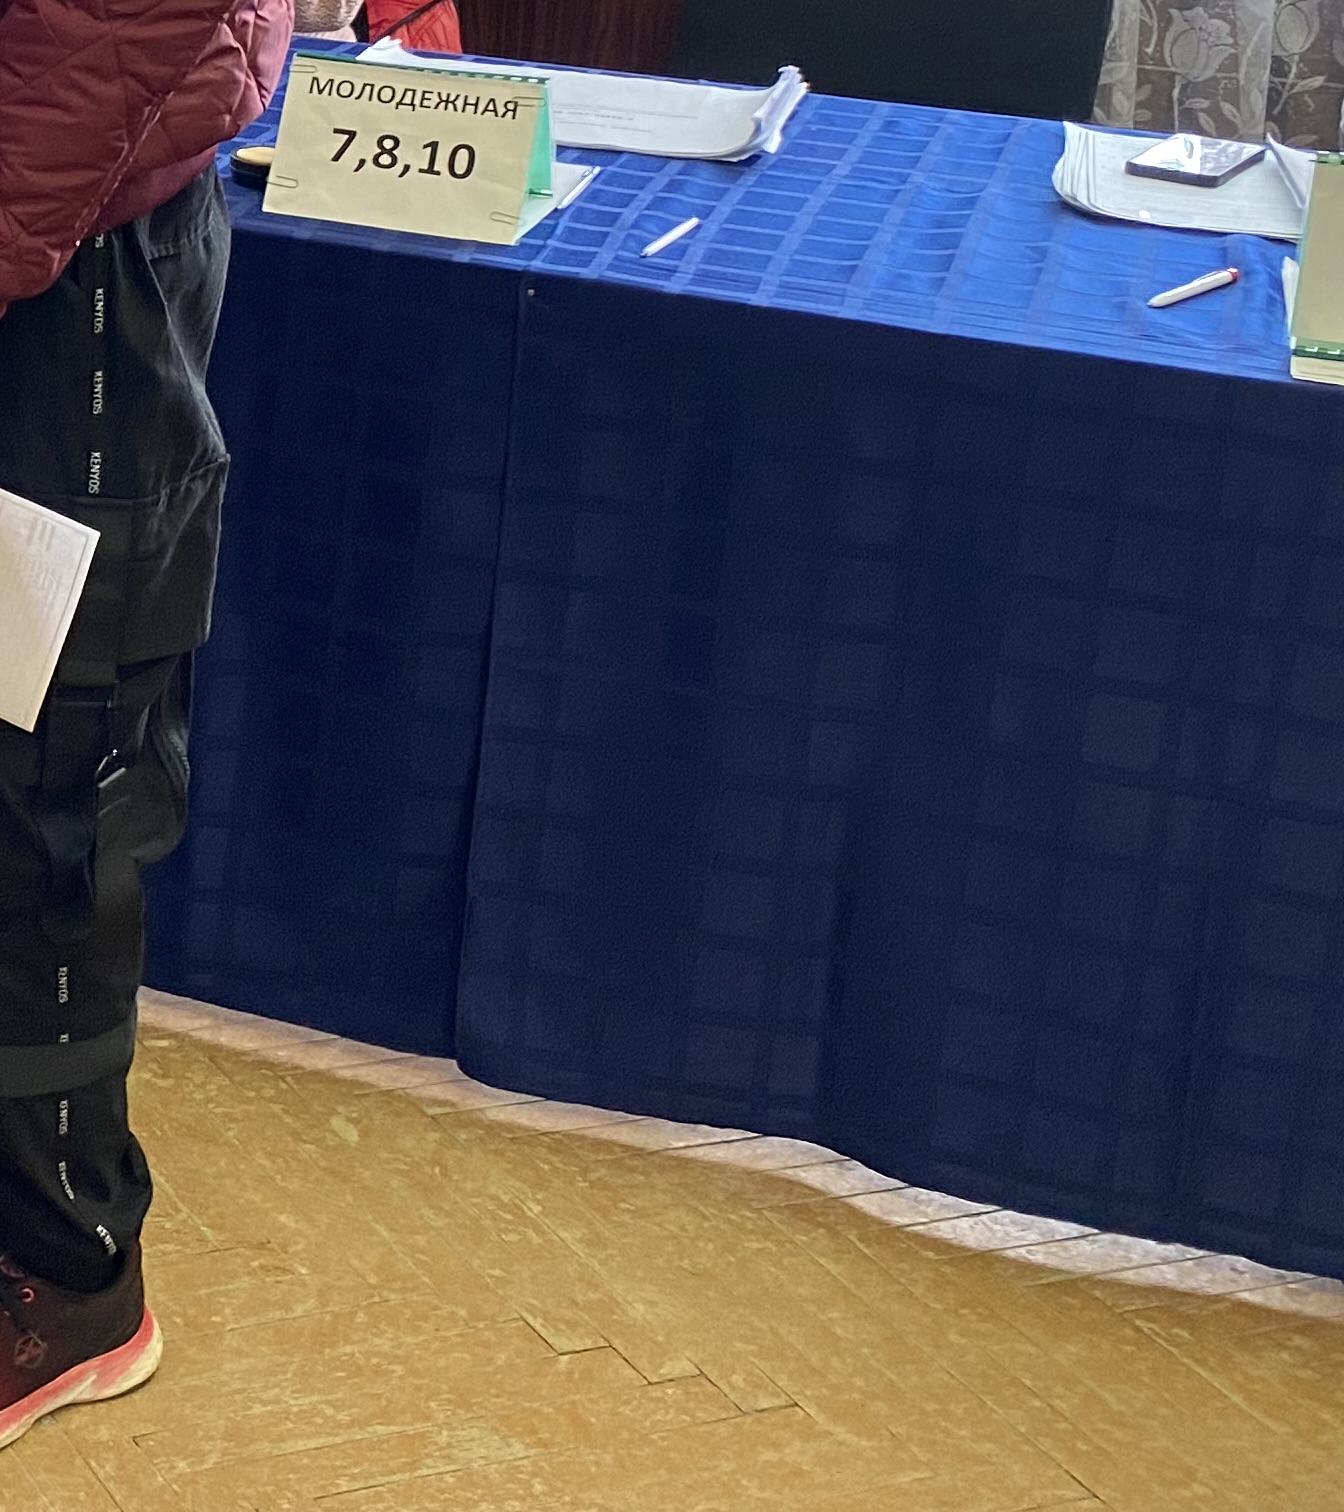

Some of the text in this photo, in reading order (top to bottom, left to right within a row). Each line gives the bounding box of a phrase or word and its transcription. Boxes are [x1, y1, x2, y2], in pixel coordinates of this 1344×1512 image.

[308, 76, 520, 121] МОЛОДЕЖНАЯ
[330, 127, 477, 180] 7,8,10
[92, 369, 104, 415] KENYOS
[87, 450, 102, 495] KENYOS
